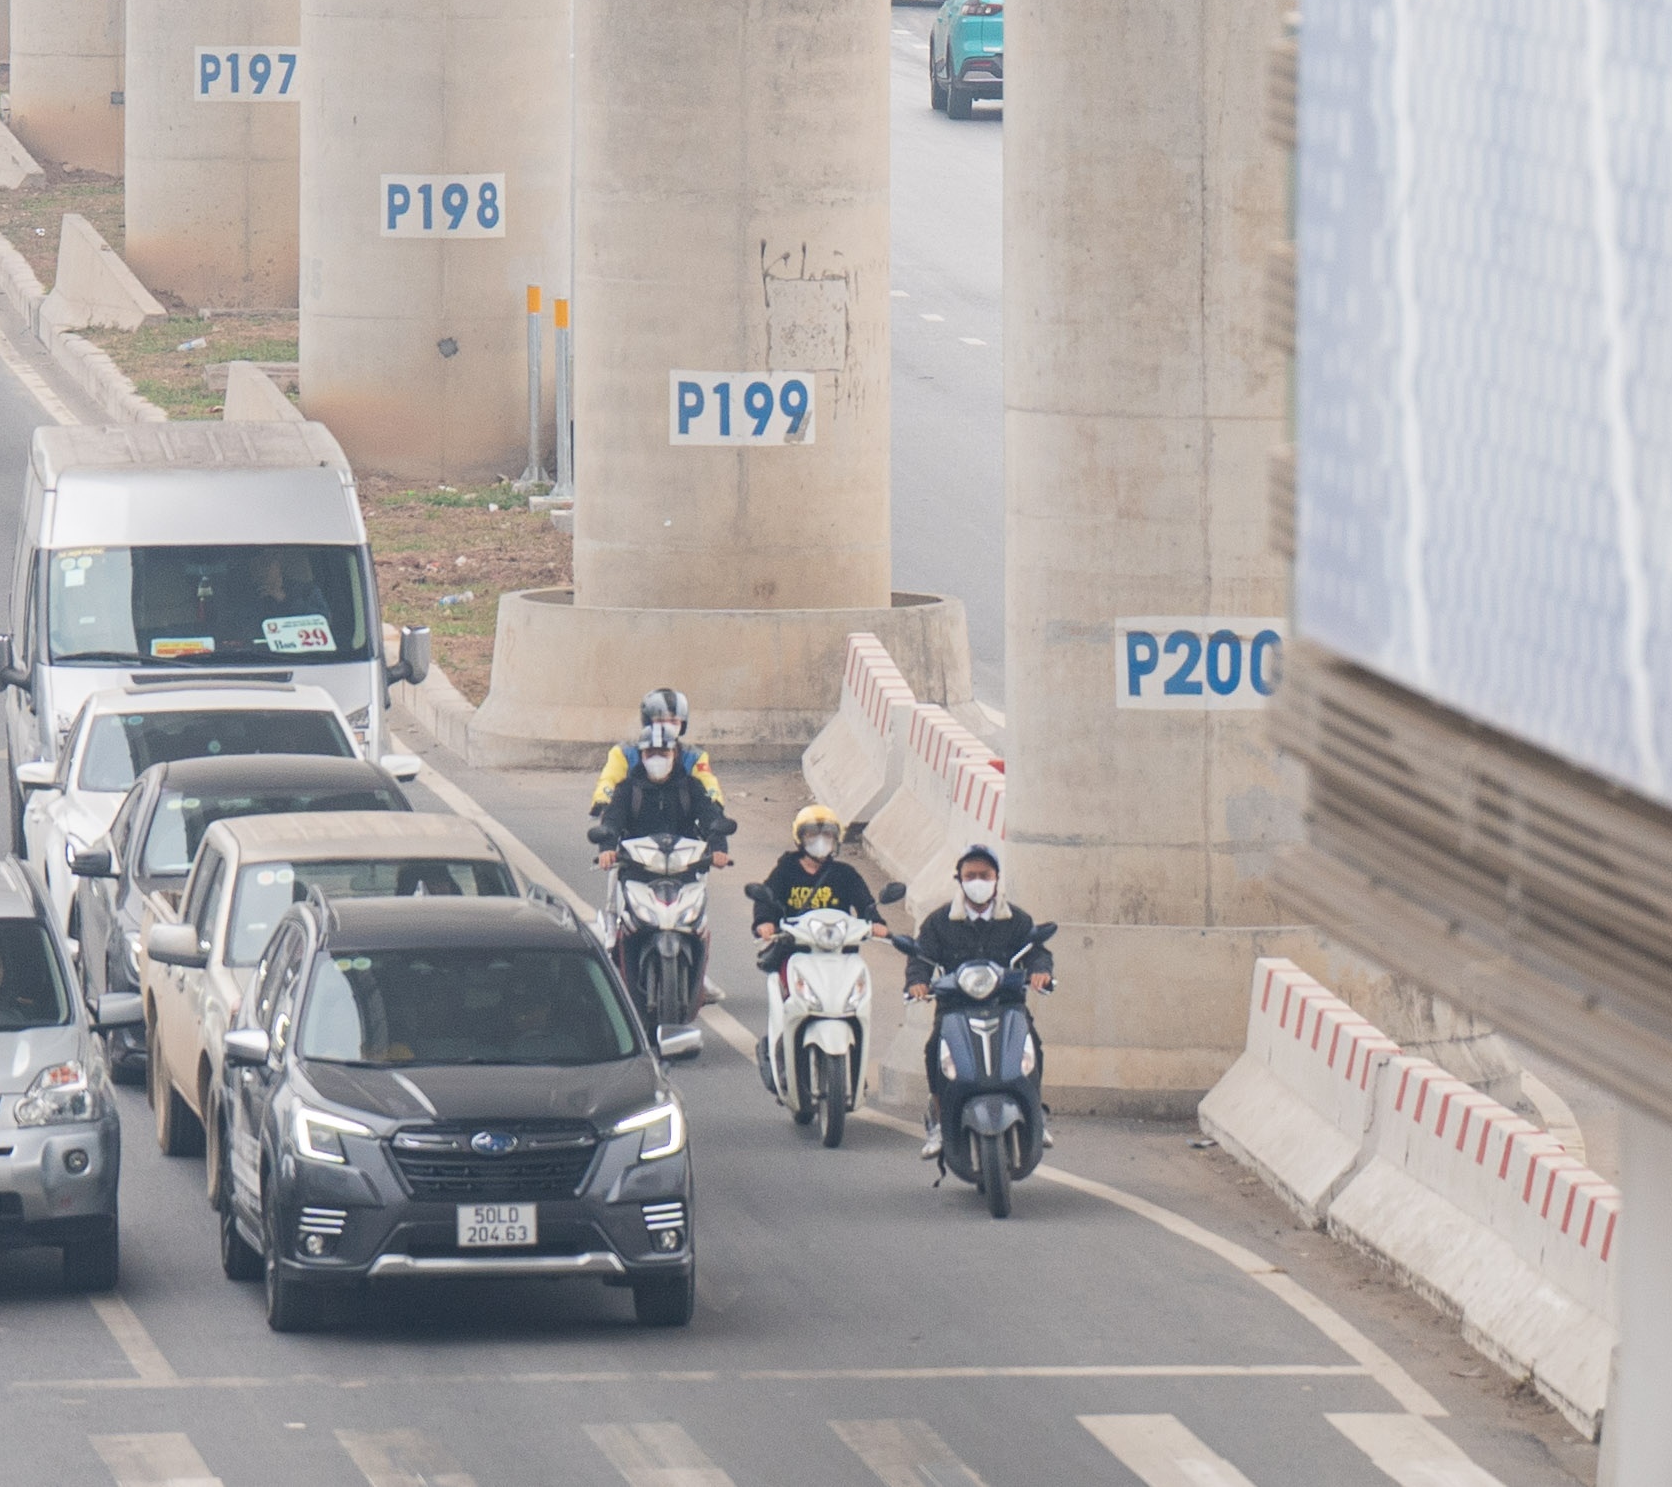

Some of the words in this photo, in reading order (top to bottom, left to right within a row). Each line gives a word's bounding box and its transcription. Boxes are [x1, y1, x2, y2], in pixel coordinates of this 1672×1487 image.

[200, 52, 297, 95] P197
[386, 181, 500, 230] P198
[677, 379, 809, 437] P199
[297, 628, 329, 647] 29
[1126, 628, 1284, 697] P200
[466, 1224, 528, 1243] 204.63
[474, 1206, 520, 1225] 50LD
